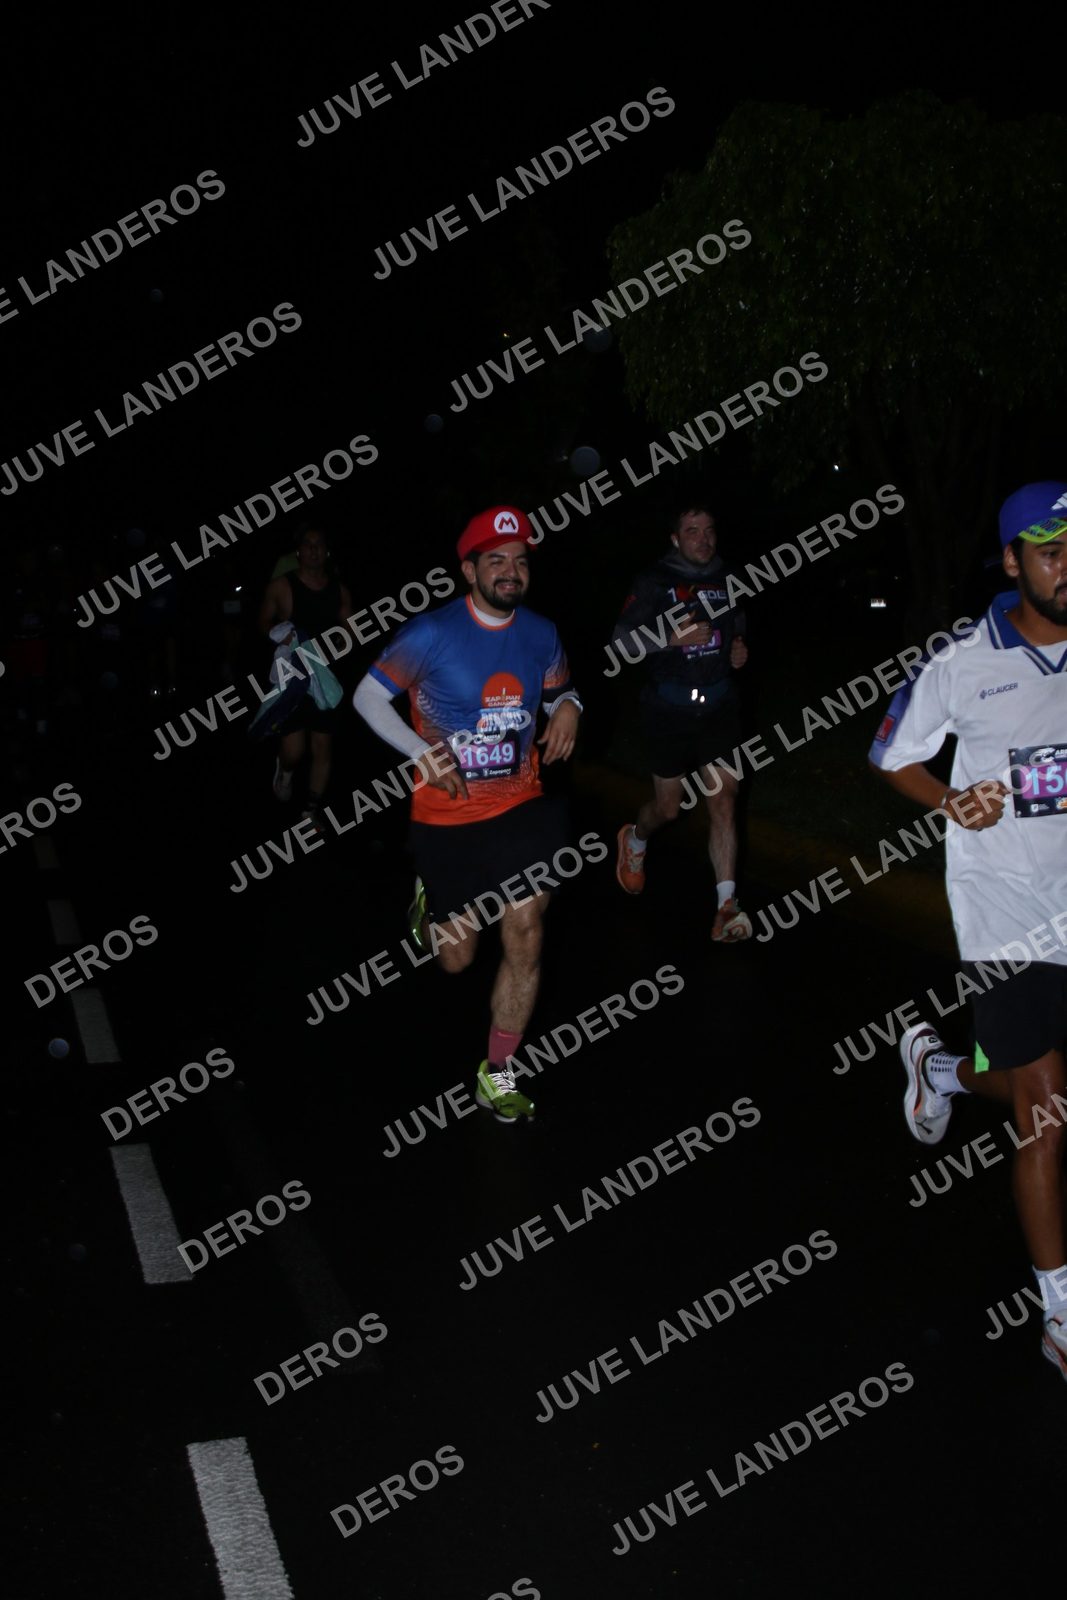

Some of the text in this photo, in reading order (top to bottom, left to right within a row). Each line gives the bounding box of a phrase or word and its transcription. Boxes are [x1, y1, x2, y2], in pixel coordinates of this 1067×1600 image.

[498, 517, 516, 530] M
[463, 743, 514, 767] 1649
[1026, 765, 1067, 795] 15
